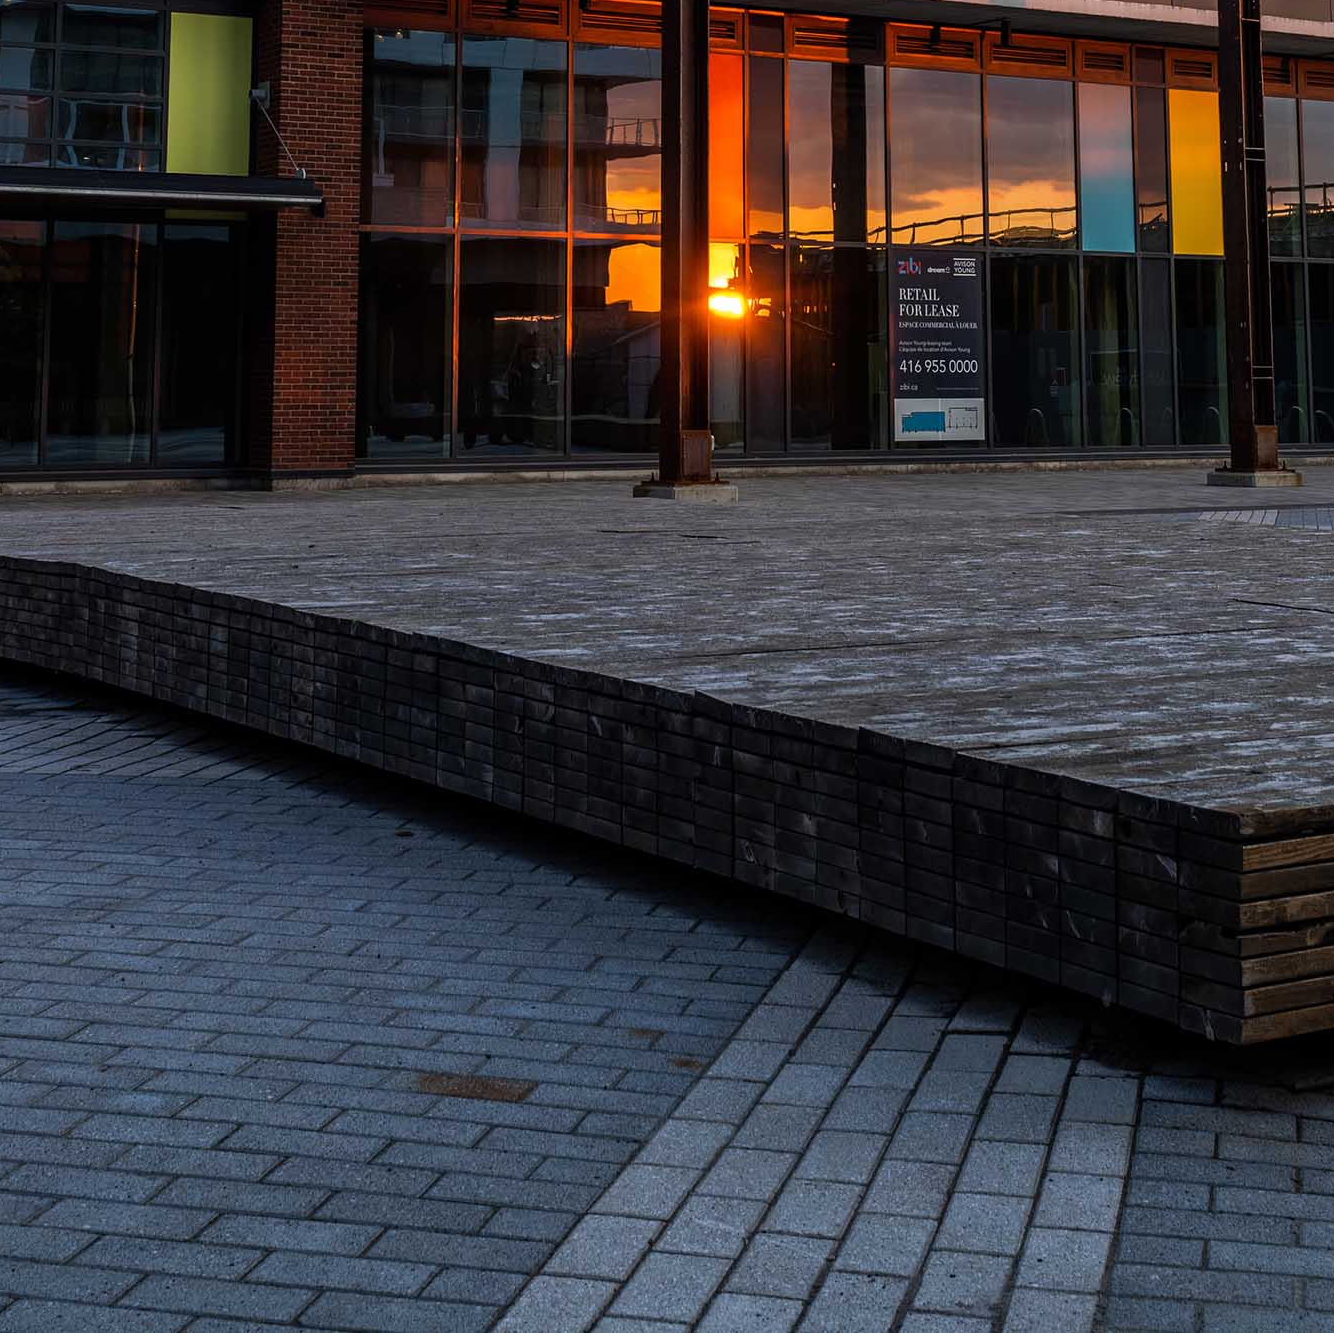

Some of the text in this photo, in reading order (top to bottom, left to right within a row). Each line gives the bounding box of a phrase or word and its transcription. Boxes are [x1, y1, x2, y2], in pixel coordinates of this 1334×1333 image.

[898, 257, 922, 275] zibi
[899, 288, 940, 301] RETAIL
[899, 303, 960, 317] FOR LEASE
[920, 321, 954, 329] COMMERCIAL
[899, 359, 978, 373] 416 955 0000
